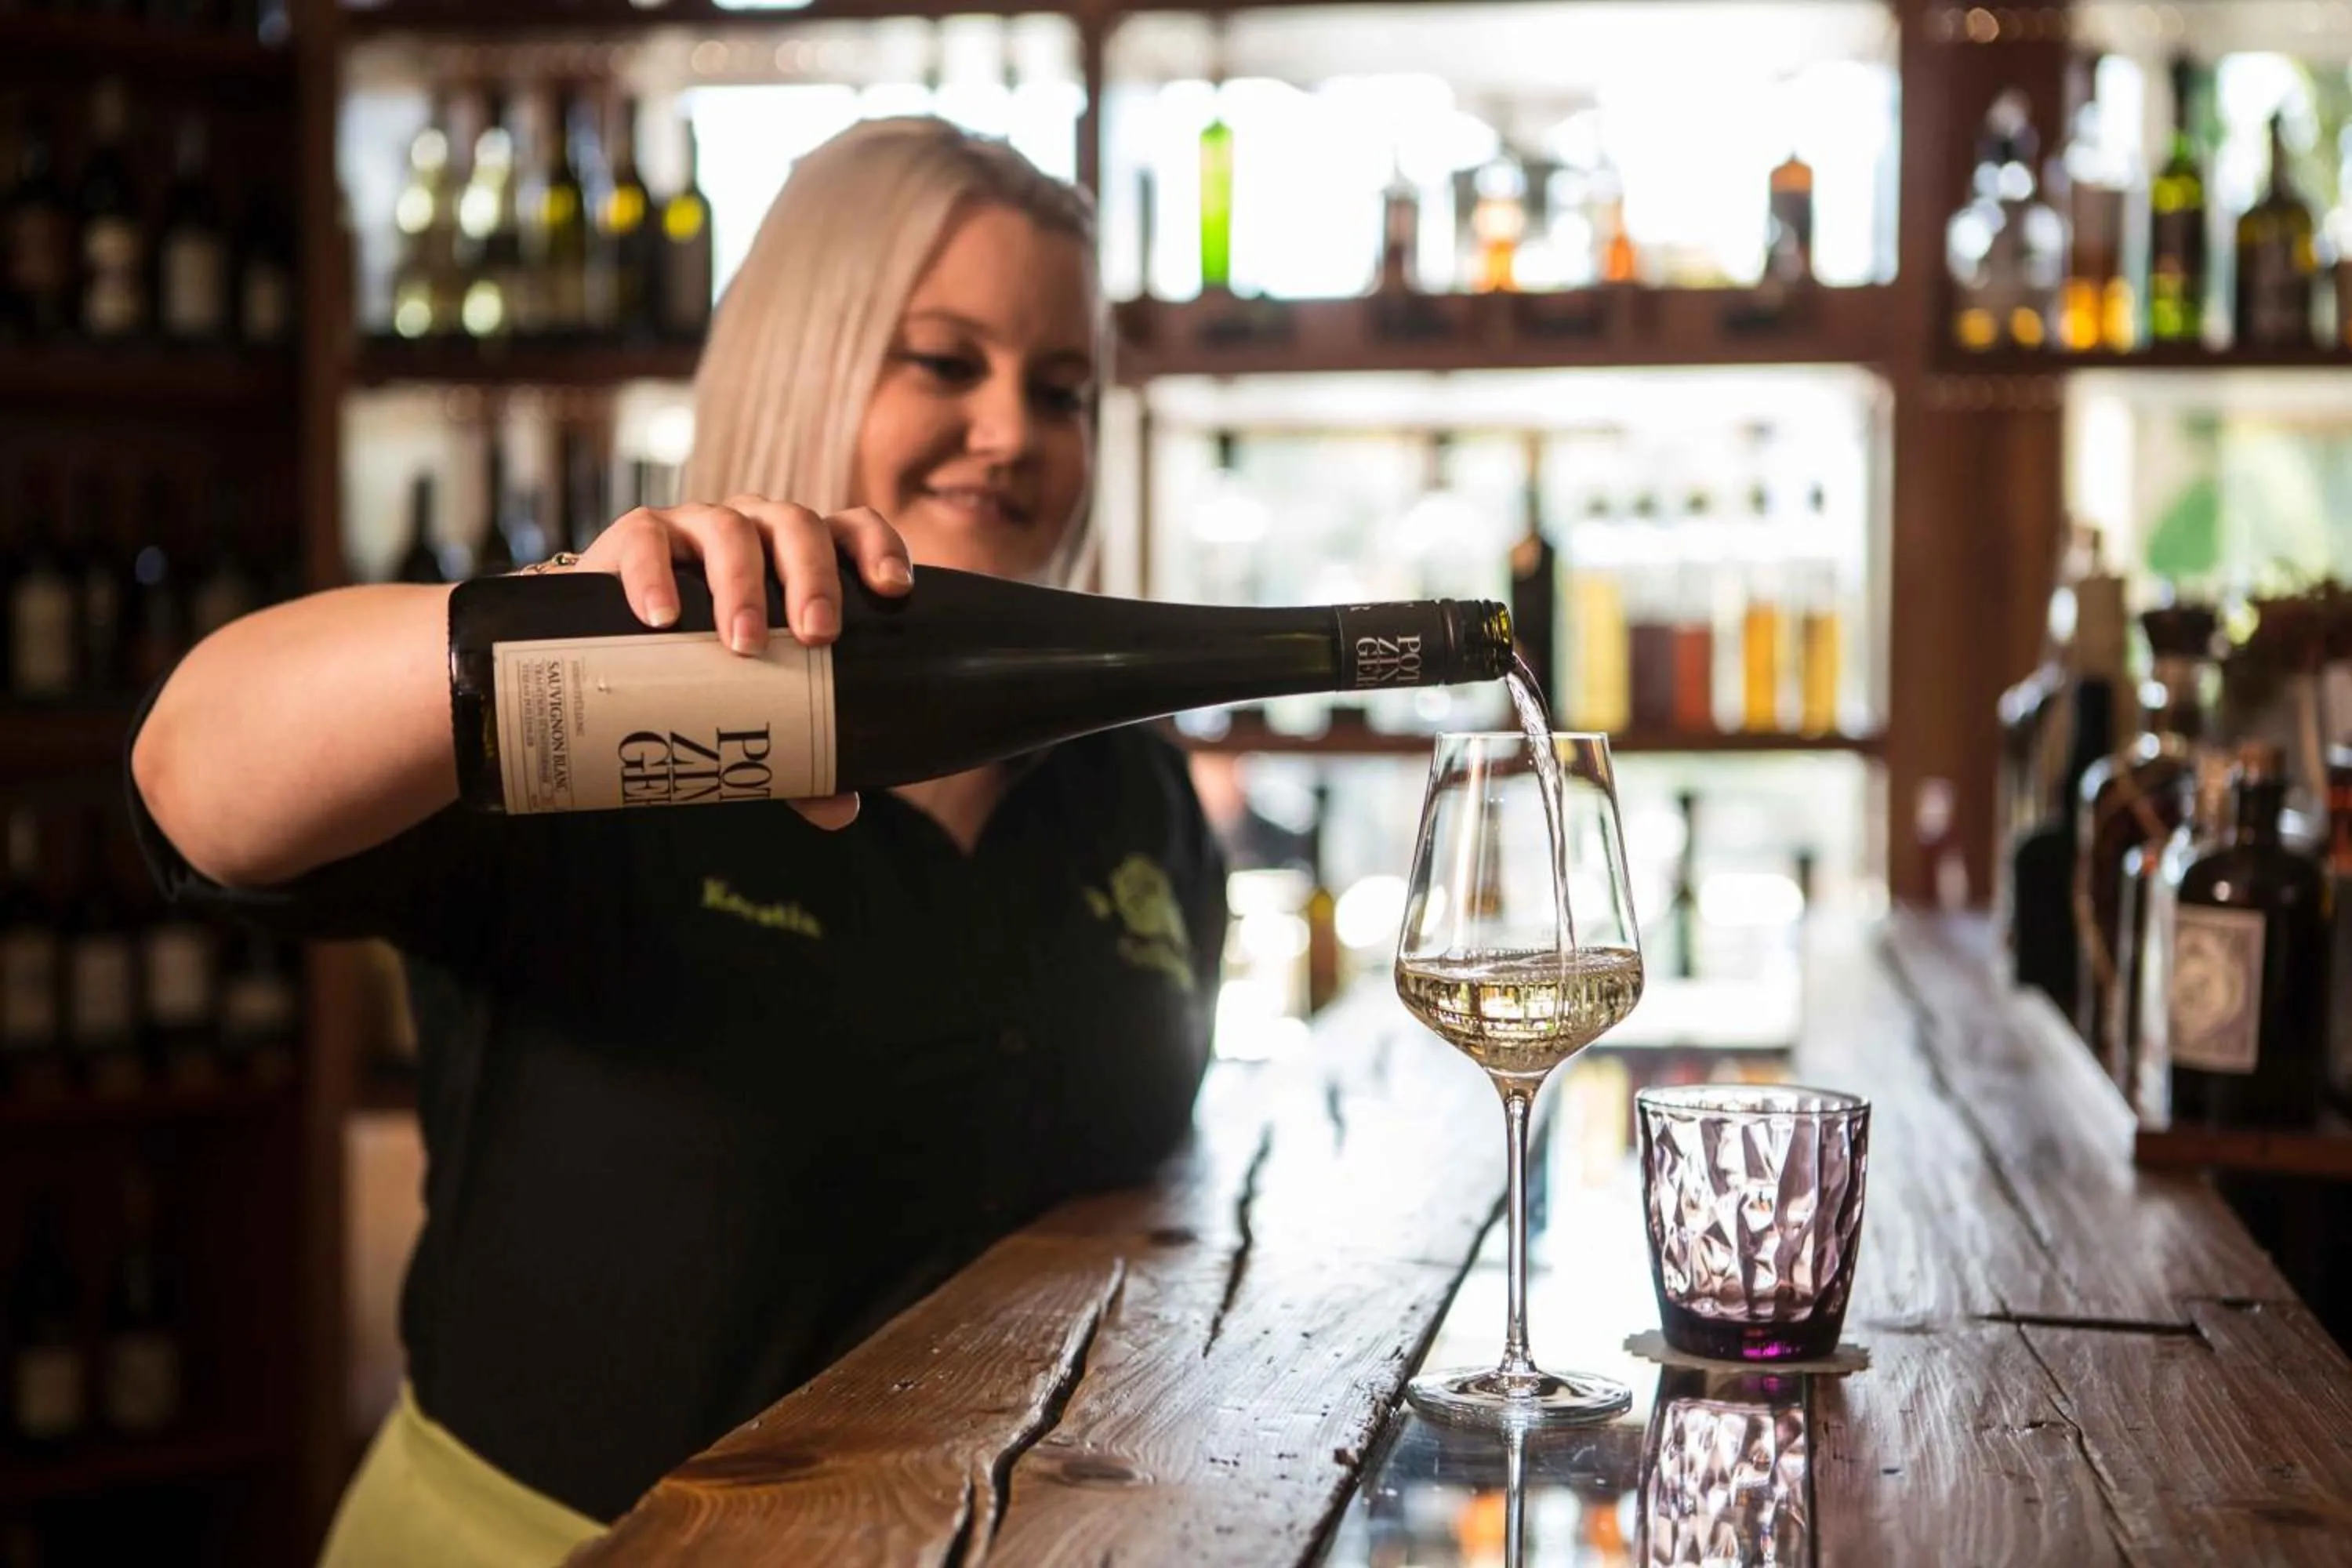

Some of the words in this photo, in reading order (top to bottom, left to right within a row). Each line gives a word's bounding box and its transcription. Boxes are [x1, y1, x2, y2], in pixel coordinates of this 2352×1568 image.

[1396, 633, 1421, 682] POT
[547, 661, 564, 751] SAUVIGNON
[552, 753, 568, 792] BLANC
